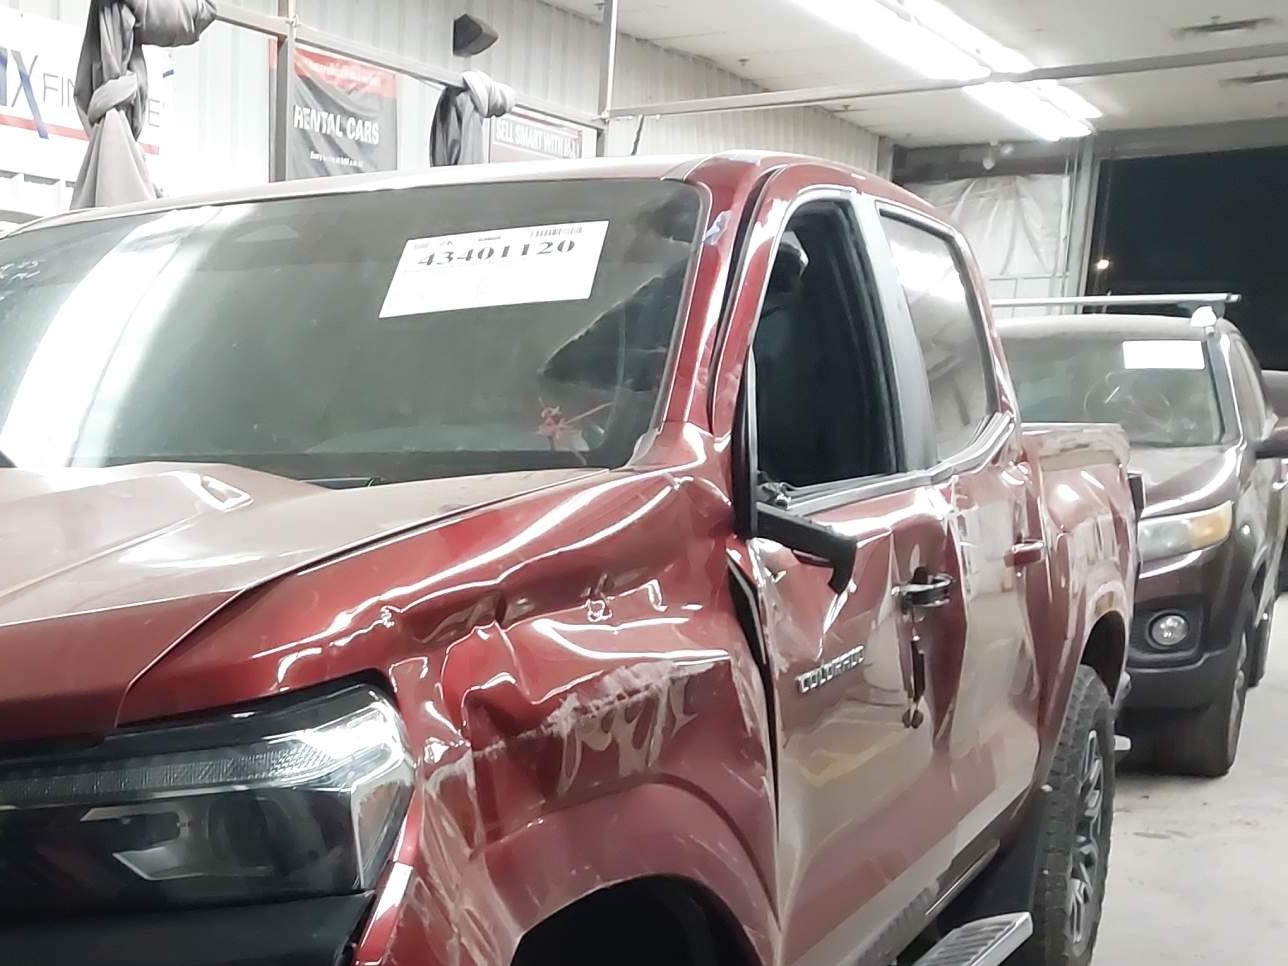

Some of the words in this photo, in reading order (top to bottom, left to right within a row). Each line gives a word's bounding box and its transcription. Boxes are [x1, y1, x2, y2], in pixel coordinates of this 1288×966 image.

[293, 104, 344, 138] RENTAL
[346, 116, 380, 145] CARS
[495, 118, 513, 141] SELL
[515, 125, 543, 151] SMART
[417, 239, 576, 267] 43401120
[795, 644, 865, 694] COLORADO
